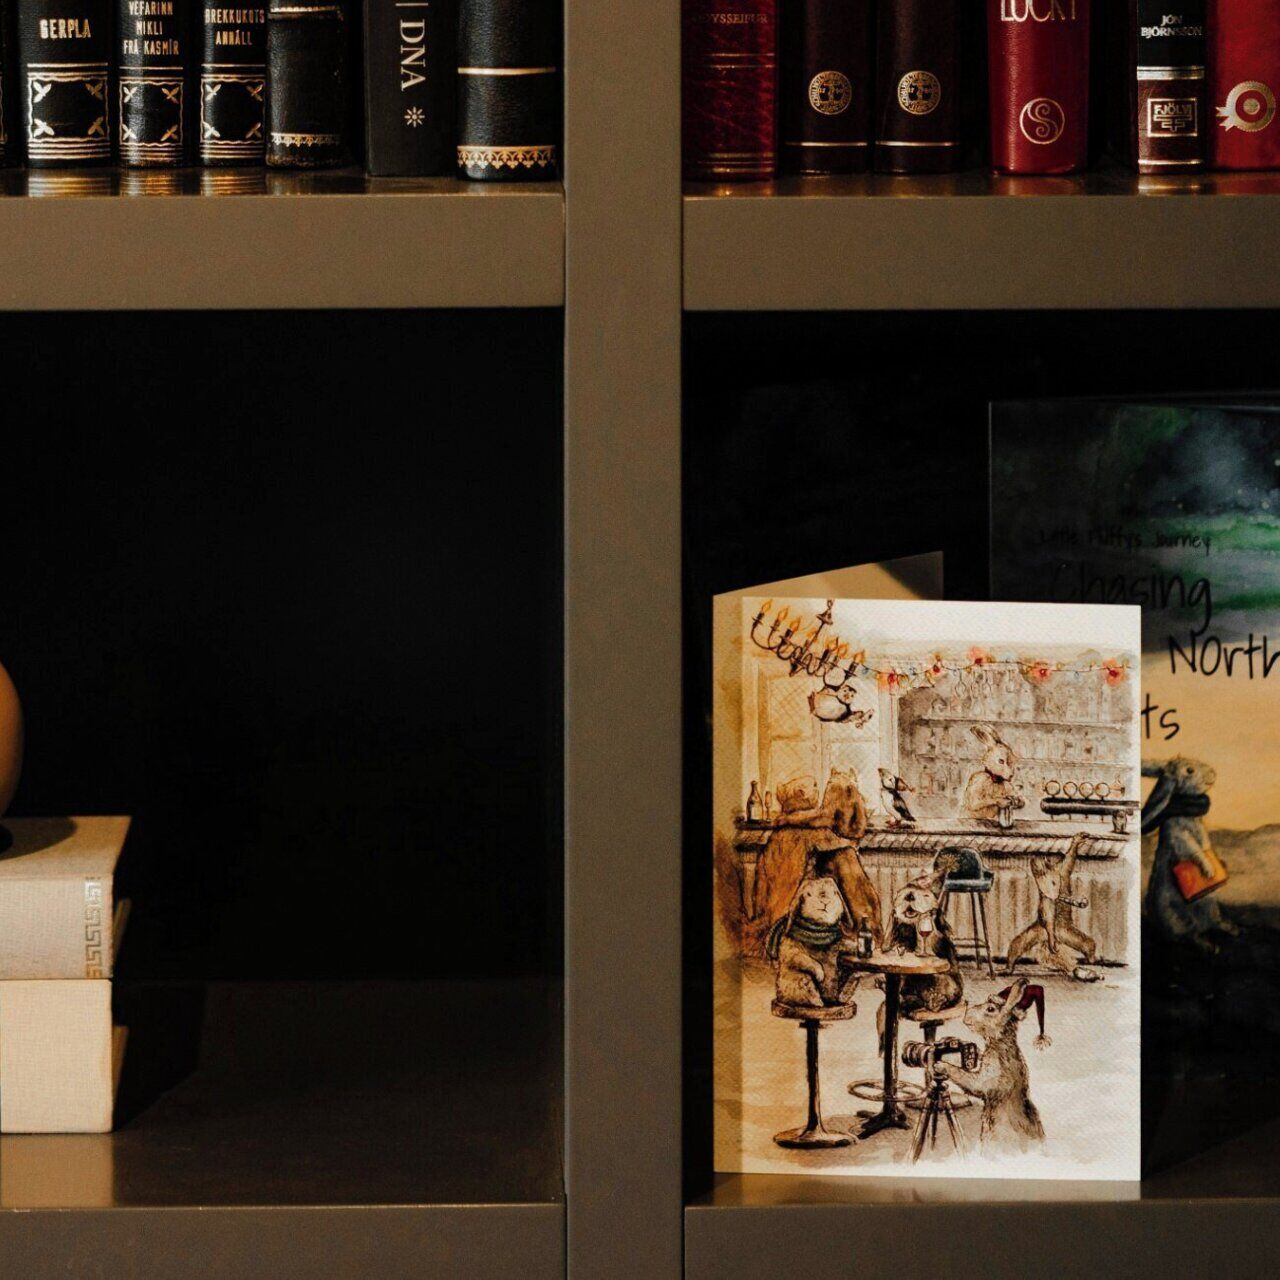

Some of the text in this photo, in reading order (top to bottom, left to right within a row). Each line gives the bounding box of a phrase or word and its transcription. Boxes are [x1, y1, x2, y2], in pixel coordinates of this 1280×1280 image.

[128, 0, 173, 16] VEFARINN
[205, 9, 266, 24] BREKKUKOTS
[40, 18, 91, 40] GERPLA
[136, 20, 162, 36] MIKLI
[215, 29, 253, 46] ANNÁLL
[123, 37, 179, 56] FRÁ KASMÍR
[399, 19, 427, 91] DNA
